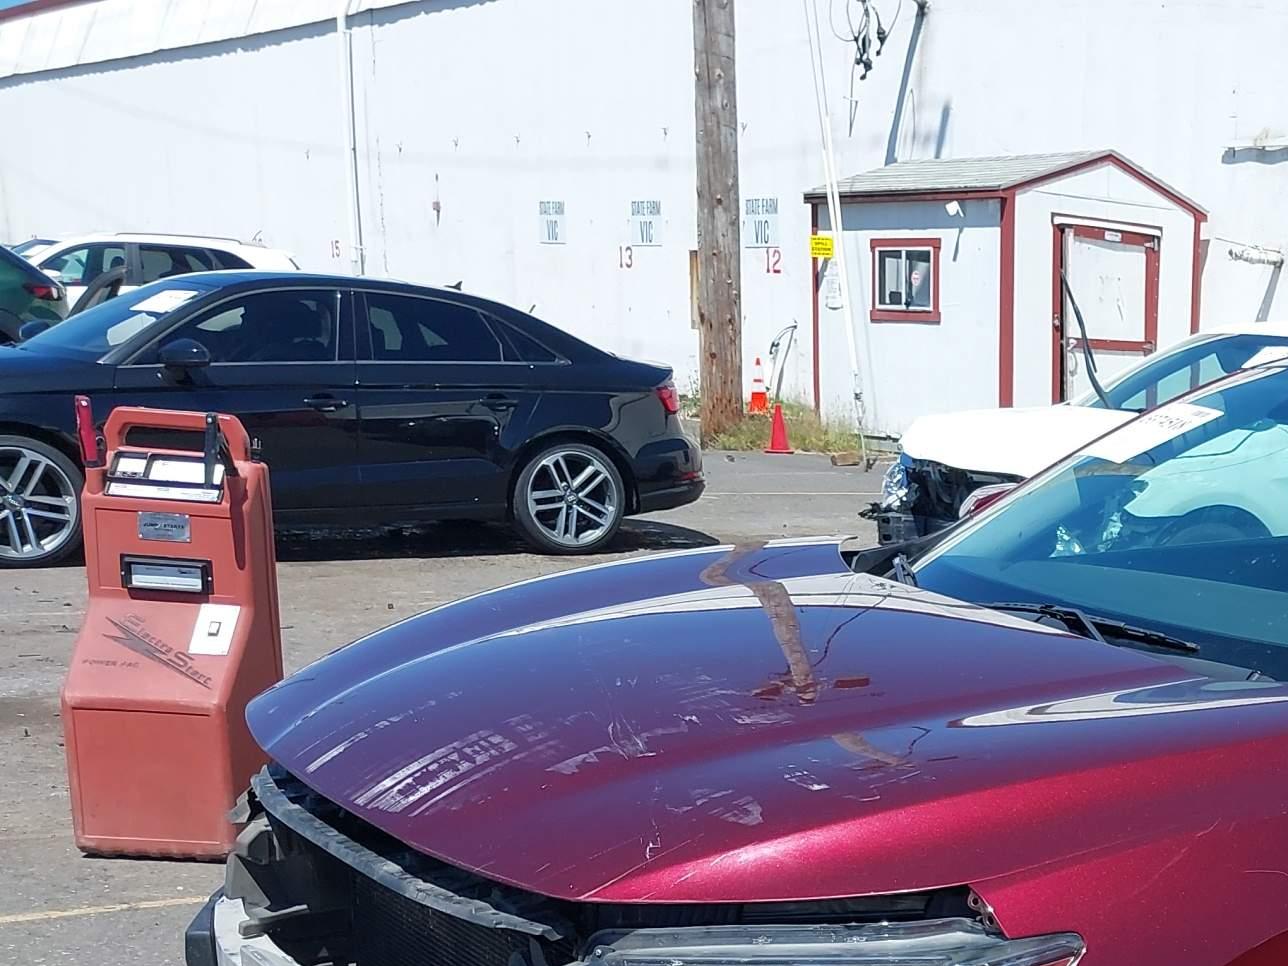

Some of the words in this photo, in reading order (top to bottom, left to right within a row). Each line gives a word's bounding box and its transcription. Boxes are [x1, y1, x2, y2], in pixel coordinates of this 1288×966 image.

[631, 201, 645, 216] STATE
[646, 201, 661, 216] FARM
[745, 200, 761, 215] STATE
[762, 198, 778, 214] FARM
[546, 219, 559, 240] VIC
[639, 220, 654, 243] VIC
[754, 220, 770, 244] VIC
[330, 240, 341, 258] 15
[619, 246, 633, 268] 13
[766, 248, 782, 273] 12
